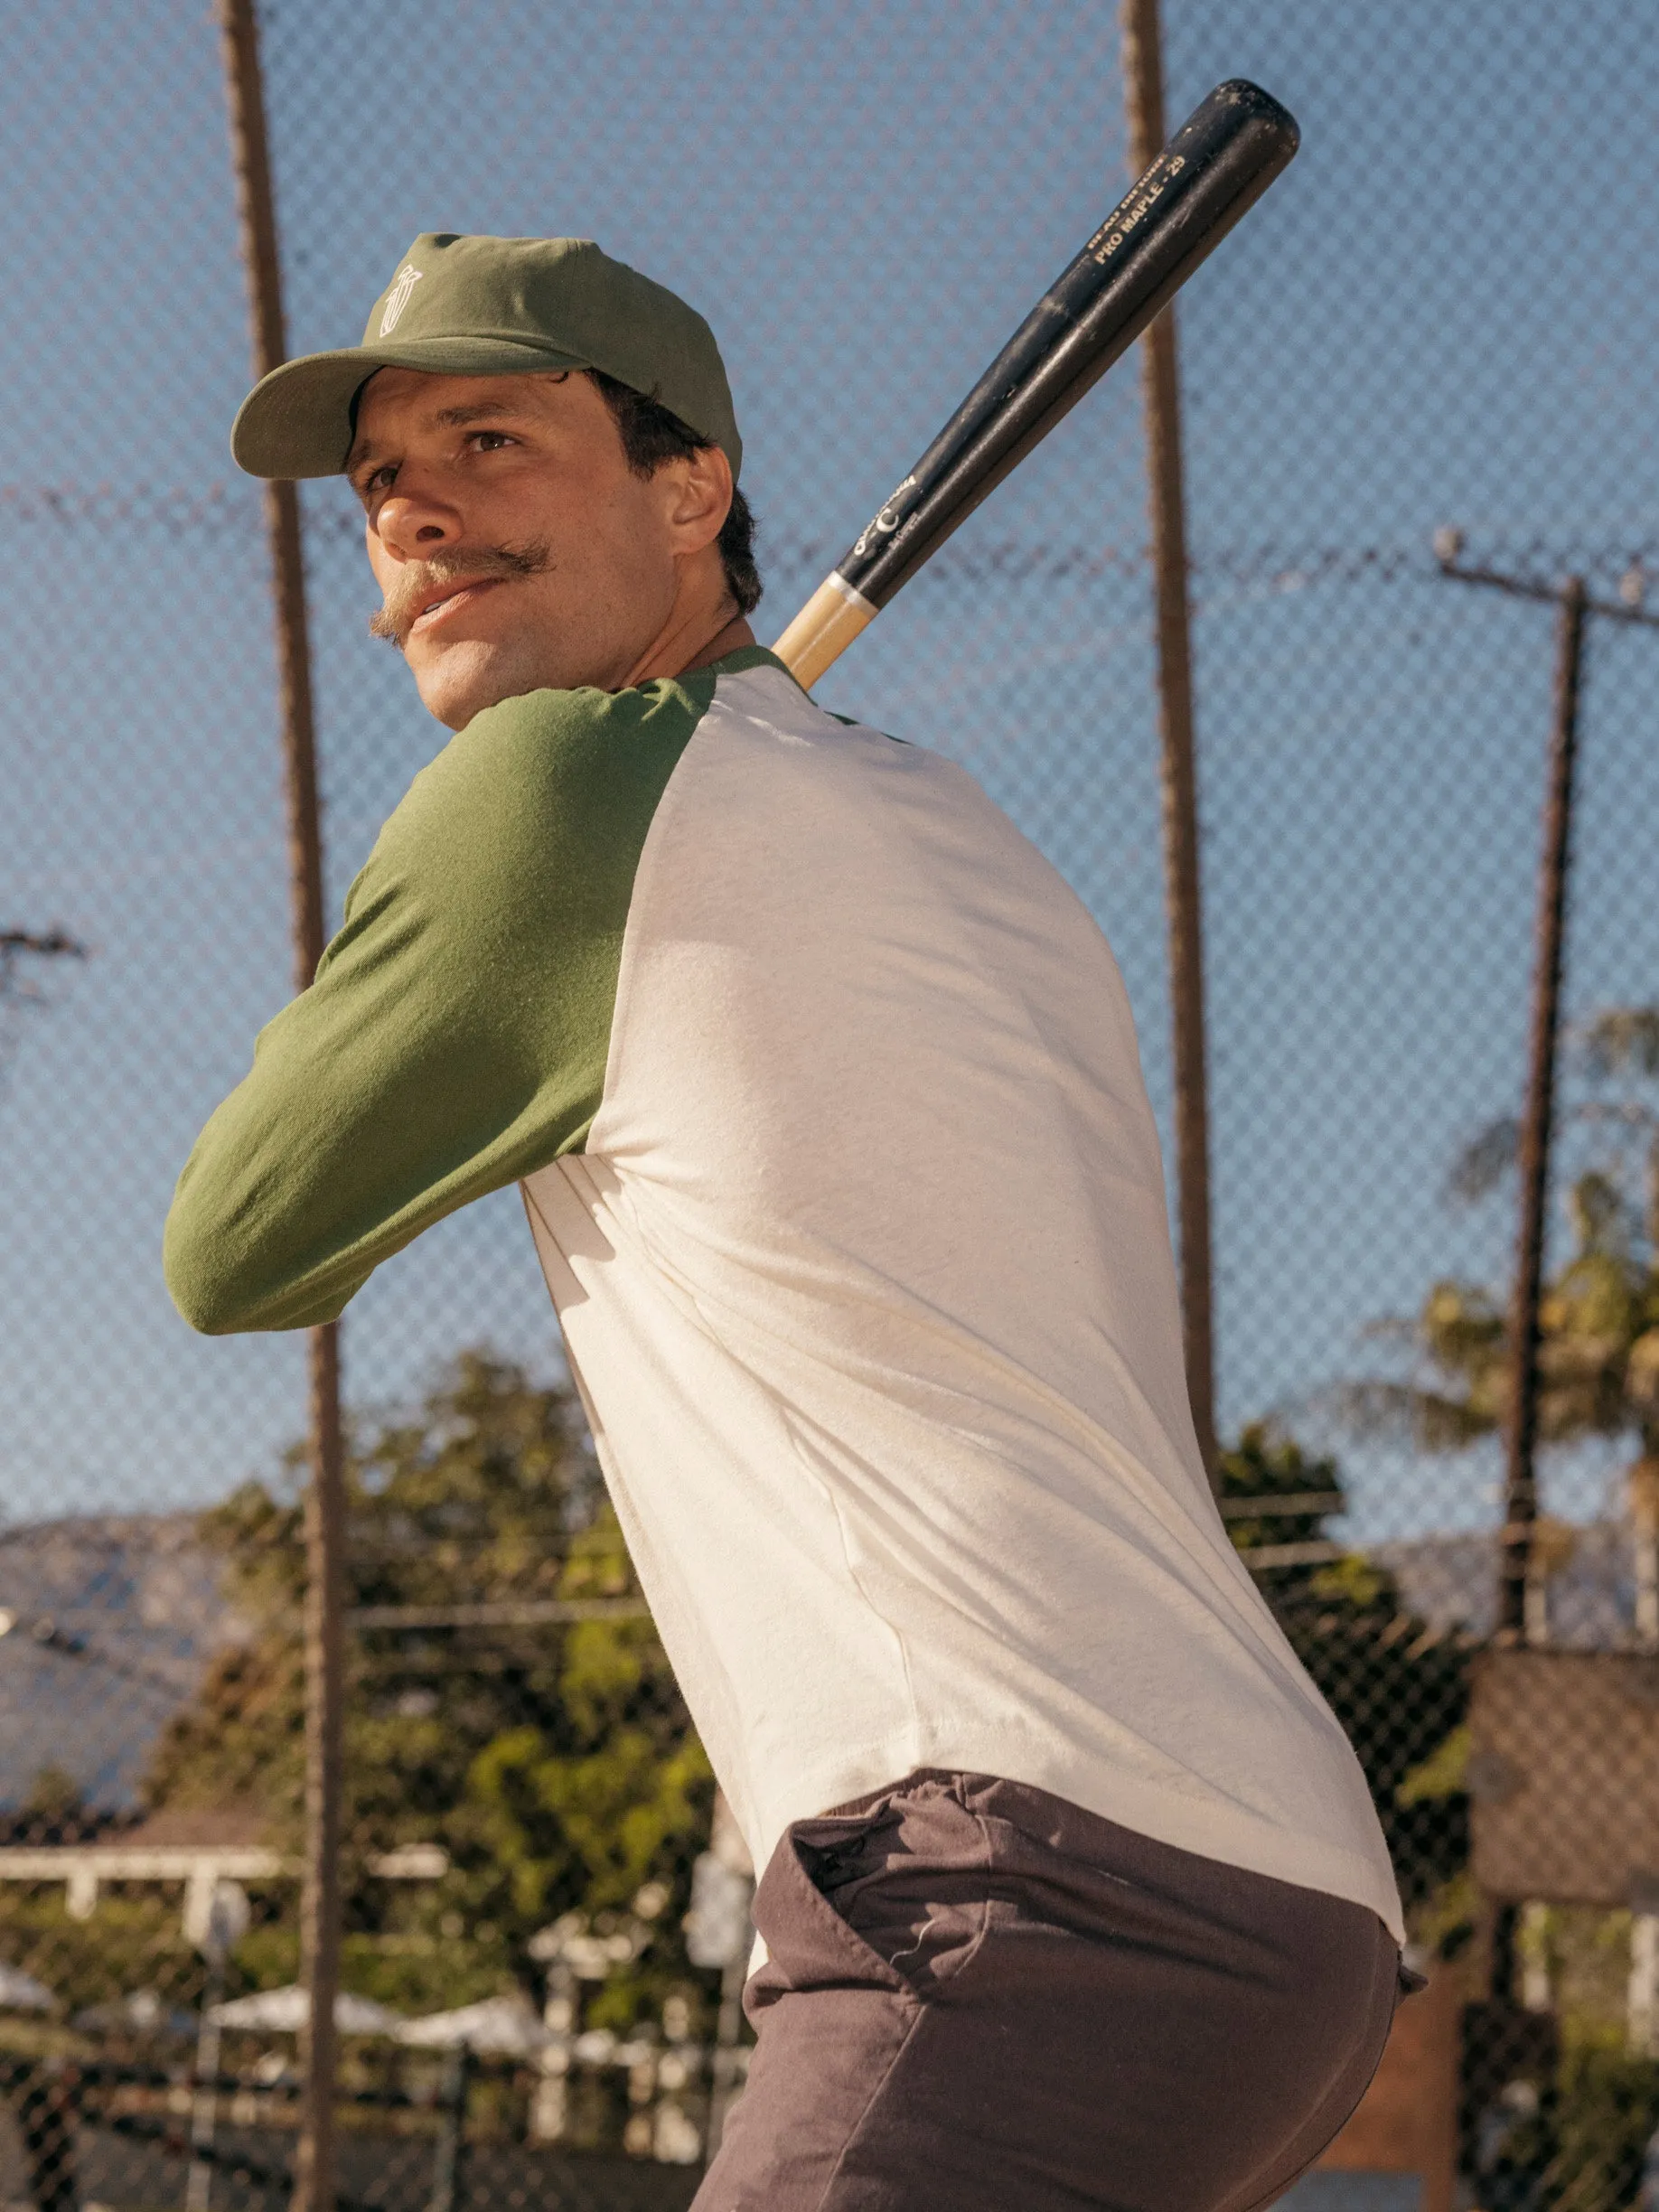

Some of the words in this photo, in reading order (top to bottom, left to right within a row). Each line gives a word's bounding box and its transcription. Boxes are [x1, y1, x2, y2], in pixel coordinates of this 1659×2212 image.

[1094, 232, 1123, 265] PRO
[1120, 182, 1165, 233] MAPLE
[1166, 155, 1186, 177] 29
